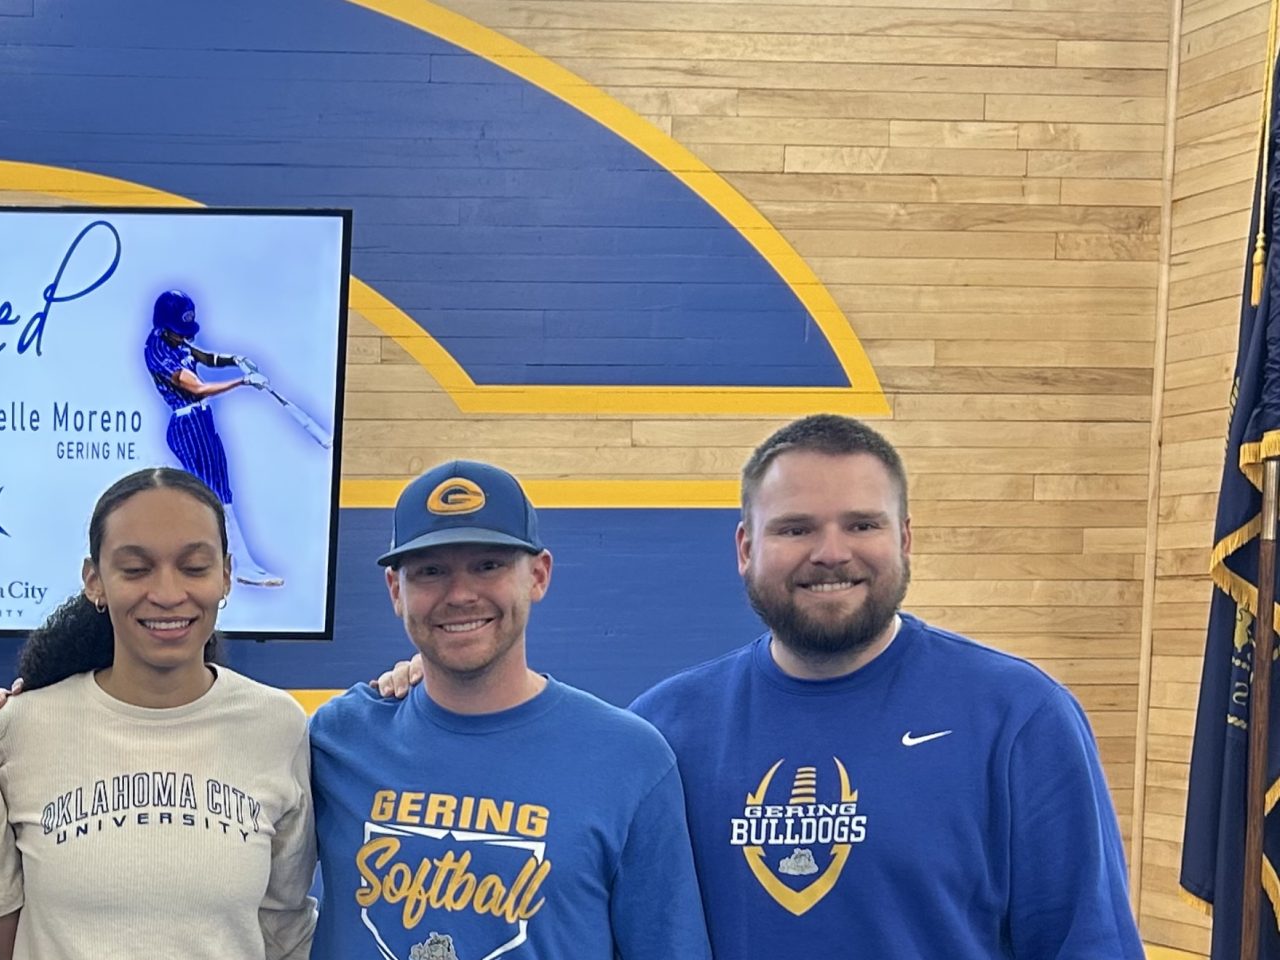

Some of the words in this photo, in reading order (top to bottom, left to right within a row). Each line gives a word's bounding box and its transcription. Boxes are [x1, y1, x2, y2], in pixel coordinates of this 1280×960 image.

[53, 402, 142, 432] Moreno
[56, 441, 110, 459] GERING
[7, 580, 48, 604] City
[40, 771, 198, 835] OKLAHOMA
[207, 779, 261, 832] CITY
[371, 790, 550, 837] GERING
[744, 803, 857, 818] GERING
[57, 812, 249, 844] UNIVERSITY
[730, 816, 867, 845] BULLDOGS
[356, 836, 551, 929] Softball
